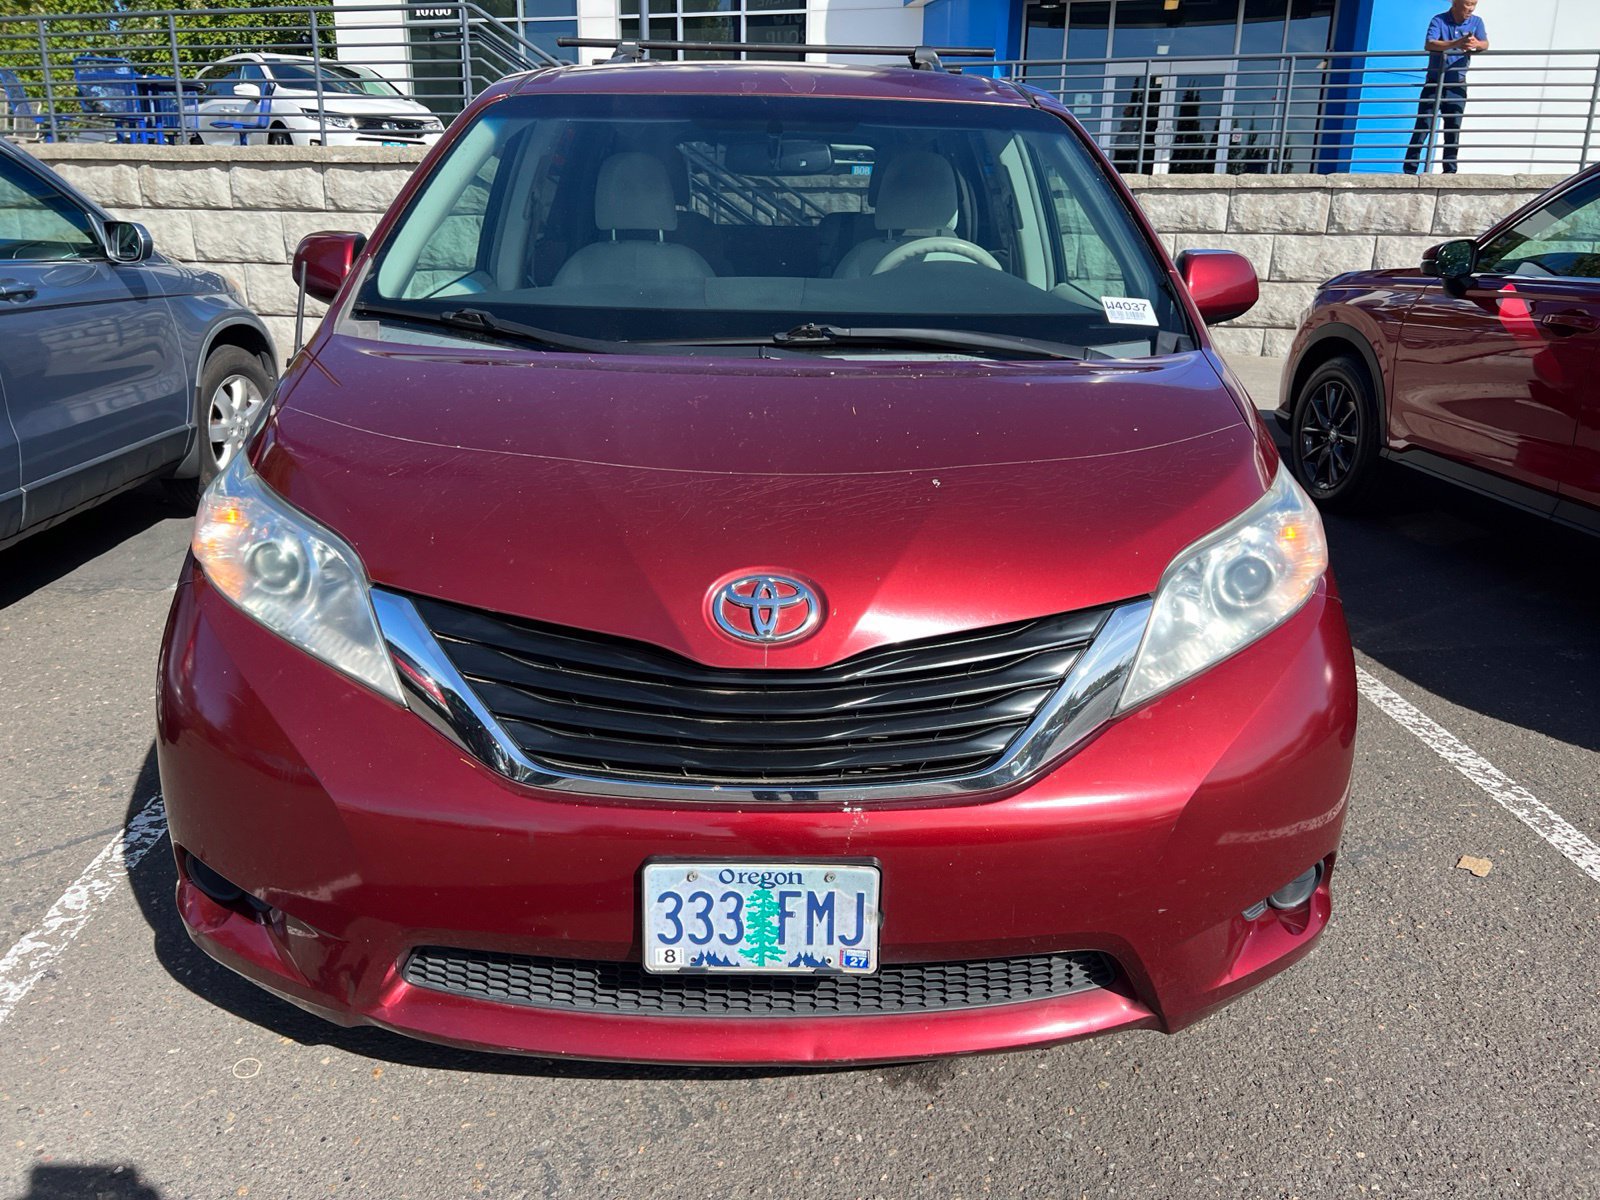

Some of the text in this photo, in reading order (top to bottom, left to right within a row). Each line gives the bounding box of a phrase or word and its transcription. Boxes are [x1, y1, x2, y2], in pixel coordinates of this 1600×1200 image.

[1104, 300, 1147, 312] W4037
[718, 868, 805, 889] Oregon
[656, 891, 865, 947] 333 FMJ
[664, 948, 677, 964] 8
[849, 956, 867, 967] 27
